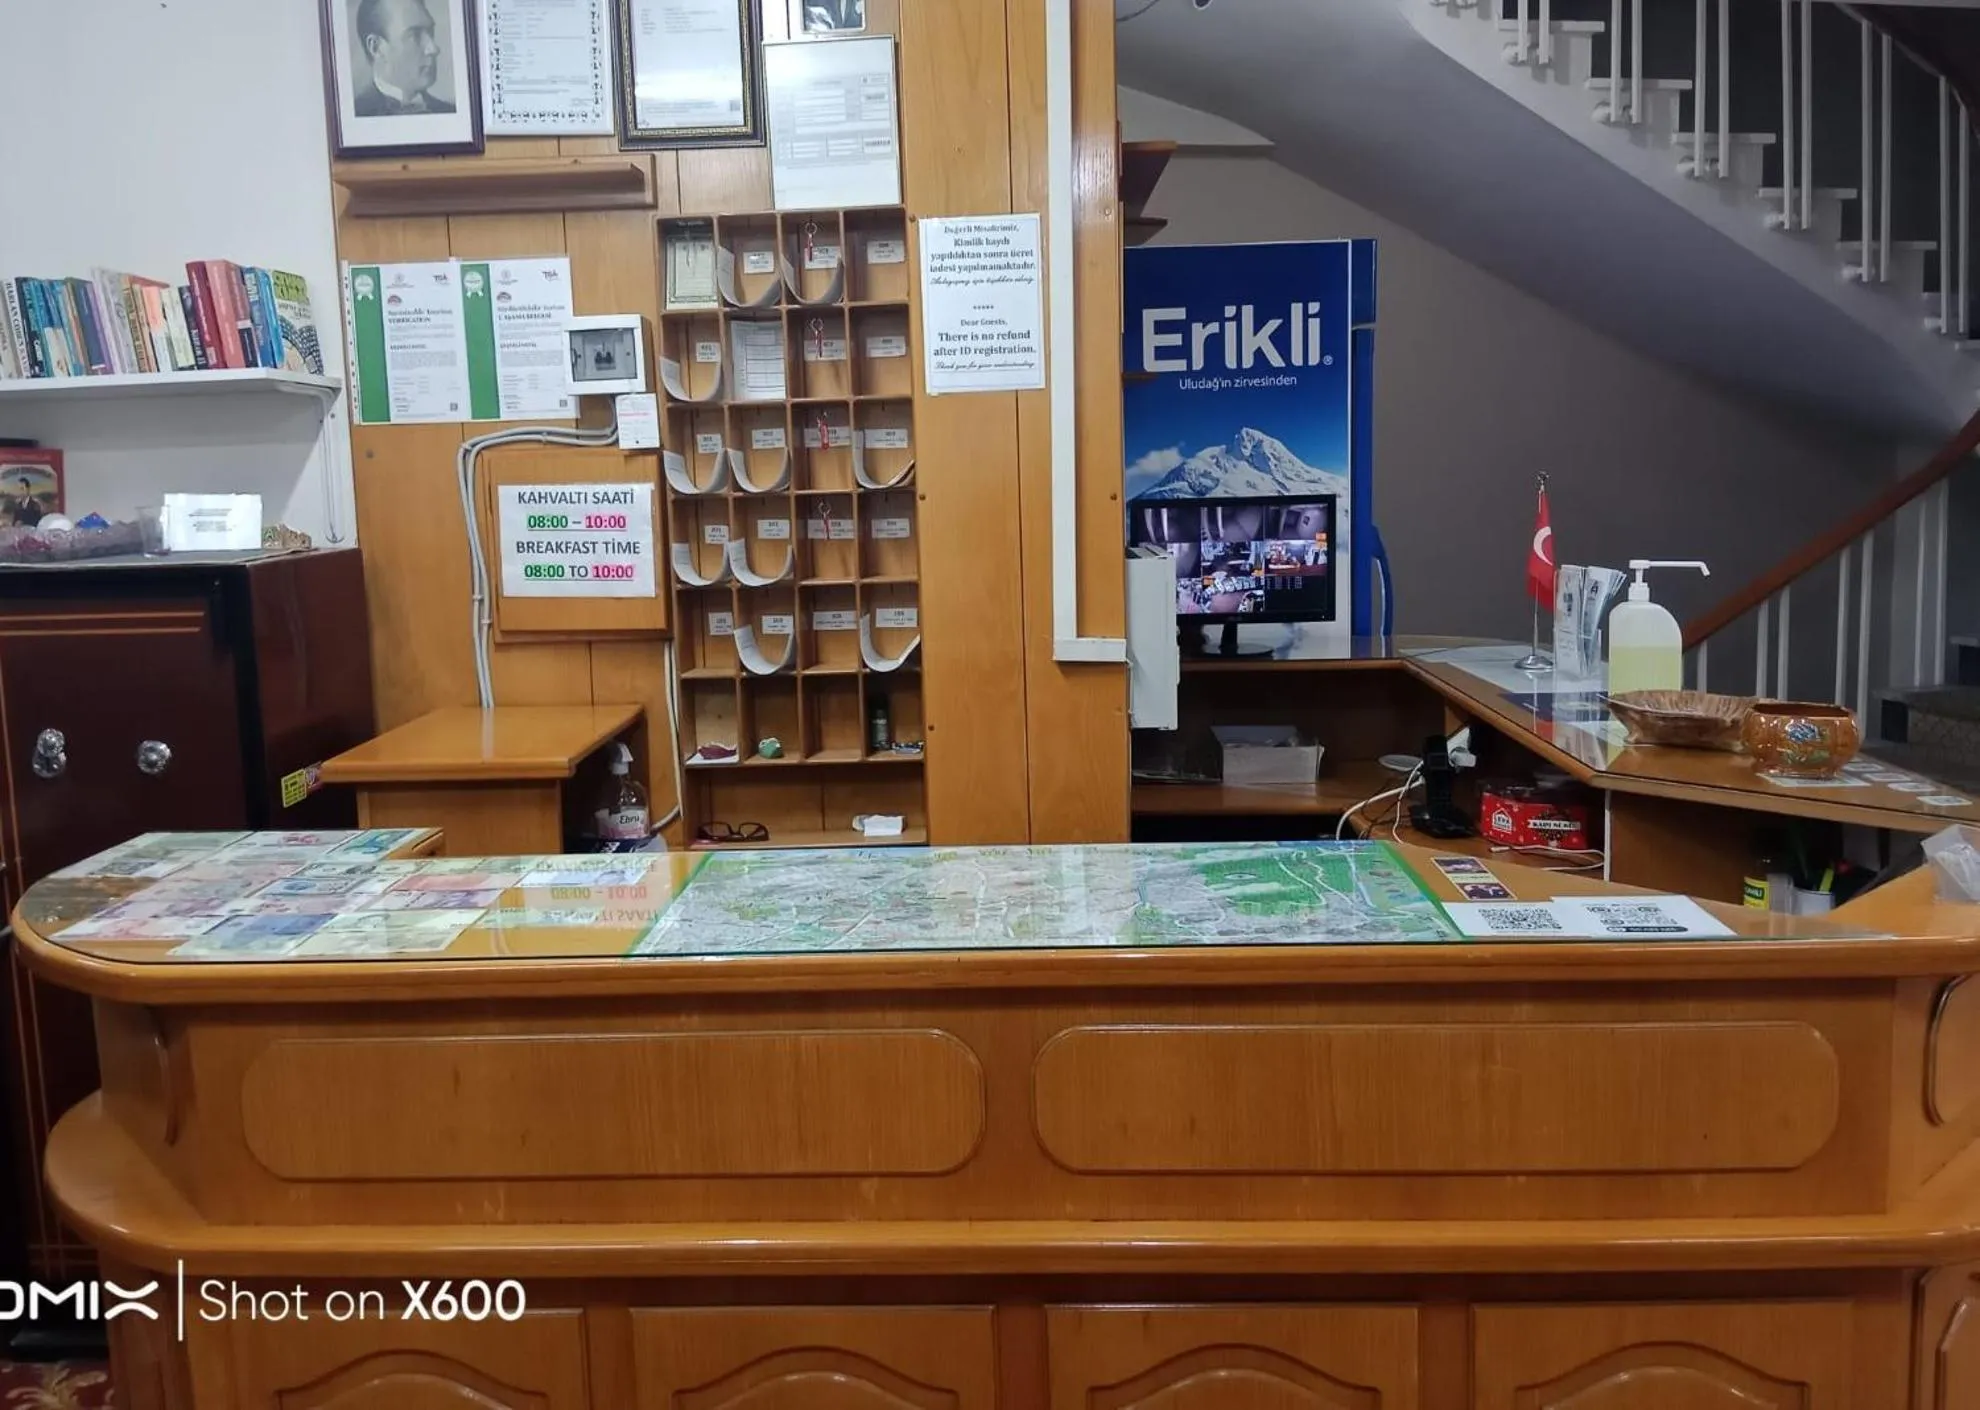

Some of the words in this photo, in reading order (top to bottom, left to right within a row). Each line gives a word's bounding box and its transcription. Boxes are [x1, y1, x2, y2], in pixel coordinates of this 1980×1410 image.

[953, 238, 985, 247] Kimlik
[1010, 249, 1034, 258] ücret
[960, 318, 979, 327] Dear
[938, 331, 969, 342] There
[970, 331, 979, 341] is
[981, 332, 995, 341] no
[996, 329, 1031, 341] refund
[1142, 302, 1321, 373] Erikli
[933, 346, 958, 357] after
[960, 346, 972, 355] ID
[973, 344, 1037, 357] registration.
[1179, 376, 1232, 392] Uludağ'ın
[1233, 374, 1298, 388] zirvesinden
[518, 491, 588, 505] KAHVALTI
[592, 488, 635, 505] SAATİ
[527, 515, 569, 529] 08:00
[585, 514, 627, 529] 10:00
[516, 540, 599, 555] BREAKFAST
[602, 537, 641, 555] TİME
[524, 564, 566, 579] 08:00
[568, 565, 589, 578] TO
[592, 564, 634, 579] 10:00
